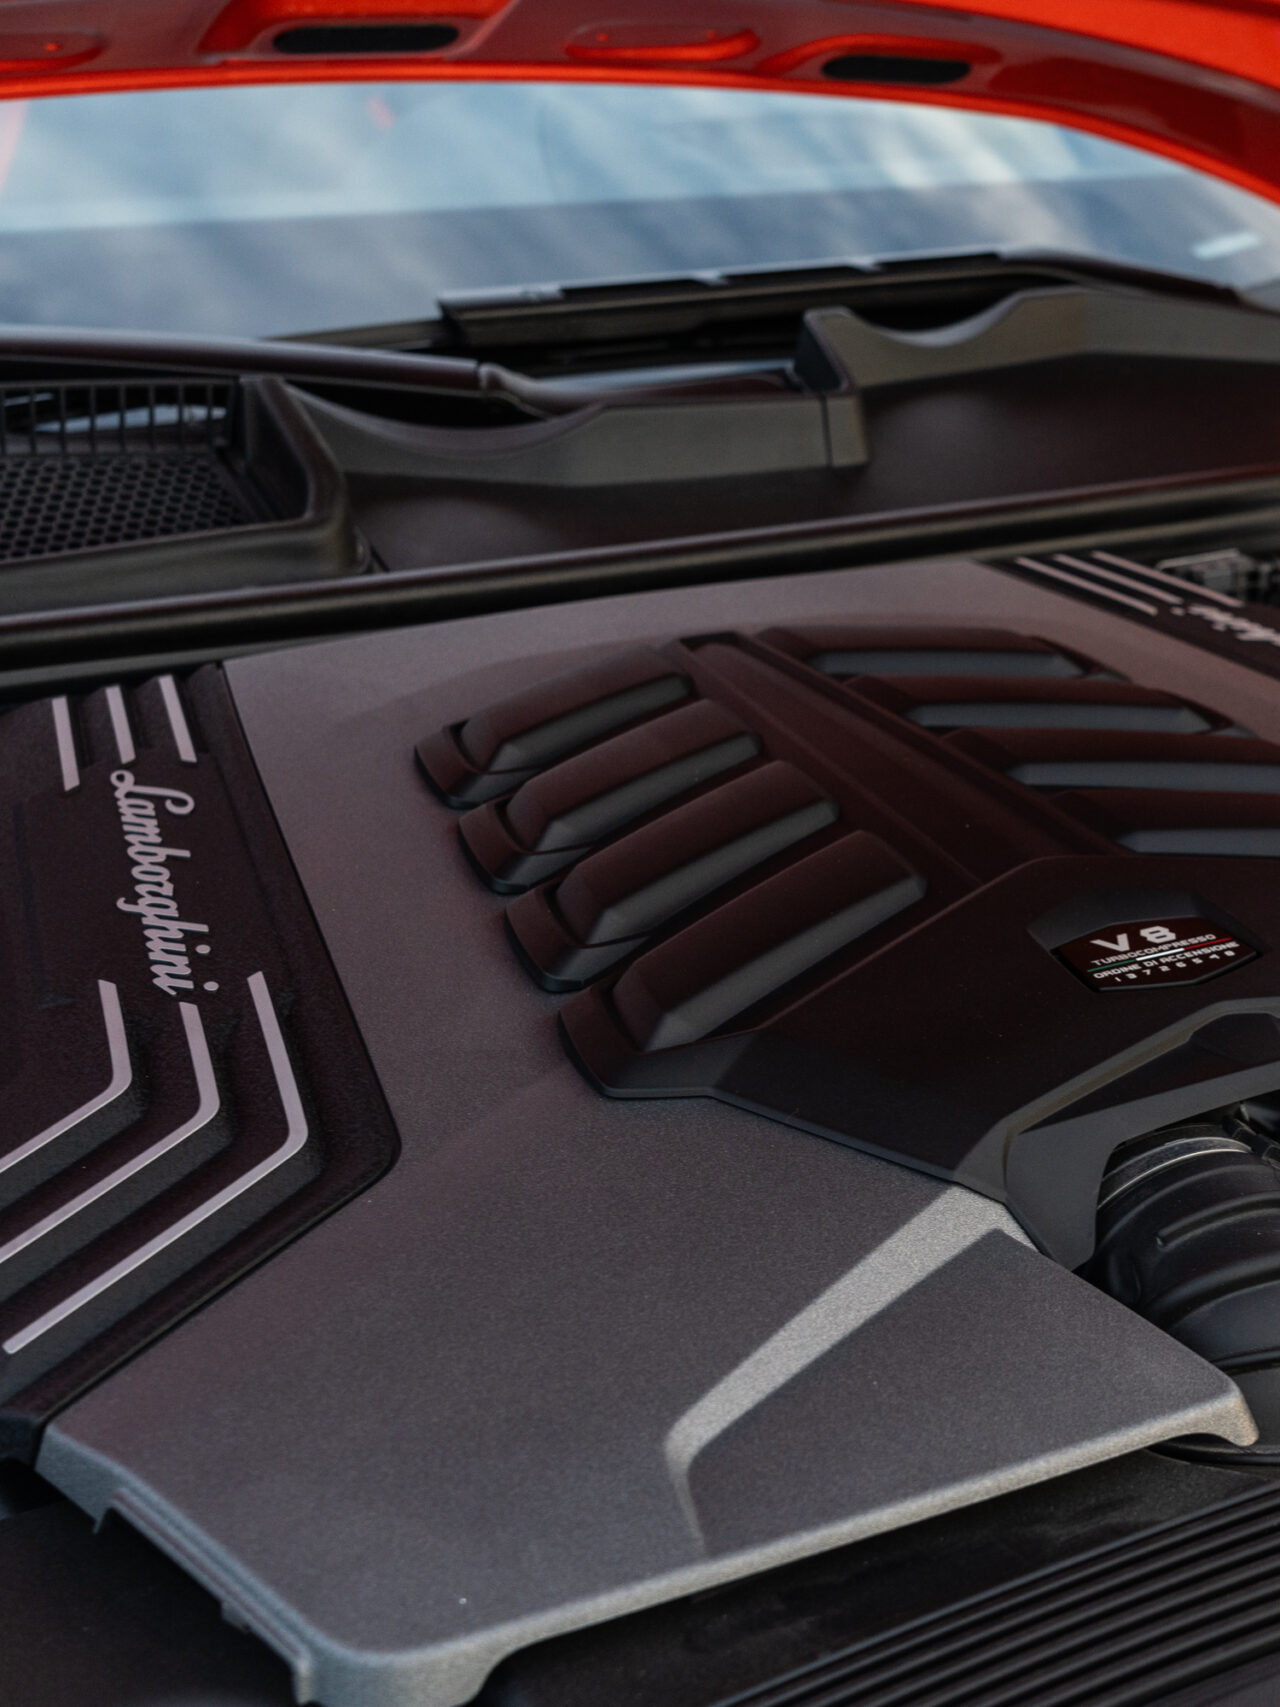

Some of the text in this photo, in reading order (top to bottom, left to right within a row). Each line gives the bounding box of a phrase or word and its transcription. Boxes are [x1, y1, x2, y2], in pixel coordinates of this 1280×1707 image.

[110, 769, 220, 996] Lamborghini
[1091, 933, 1217, 966] TURBOCOMPRESSO
[1093, 941, 1240, 979] ORDINE DI ACCENSIONE
